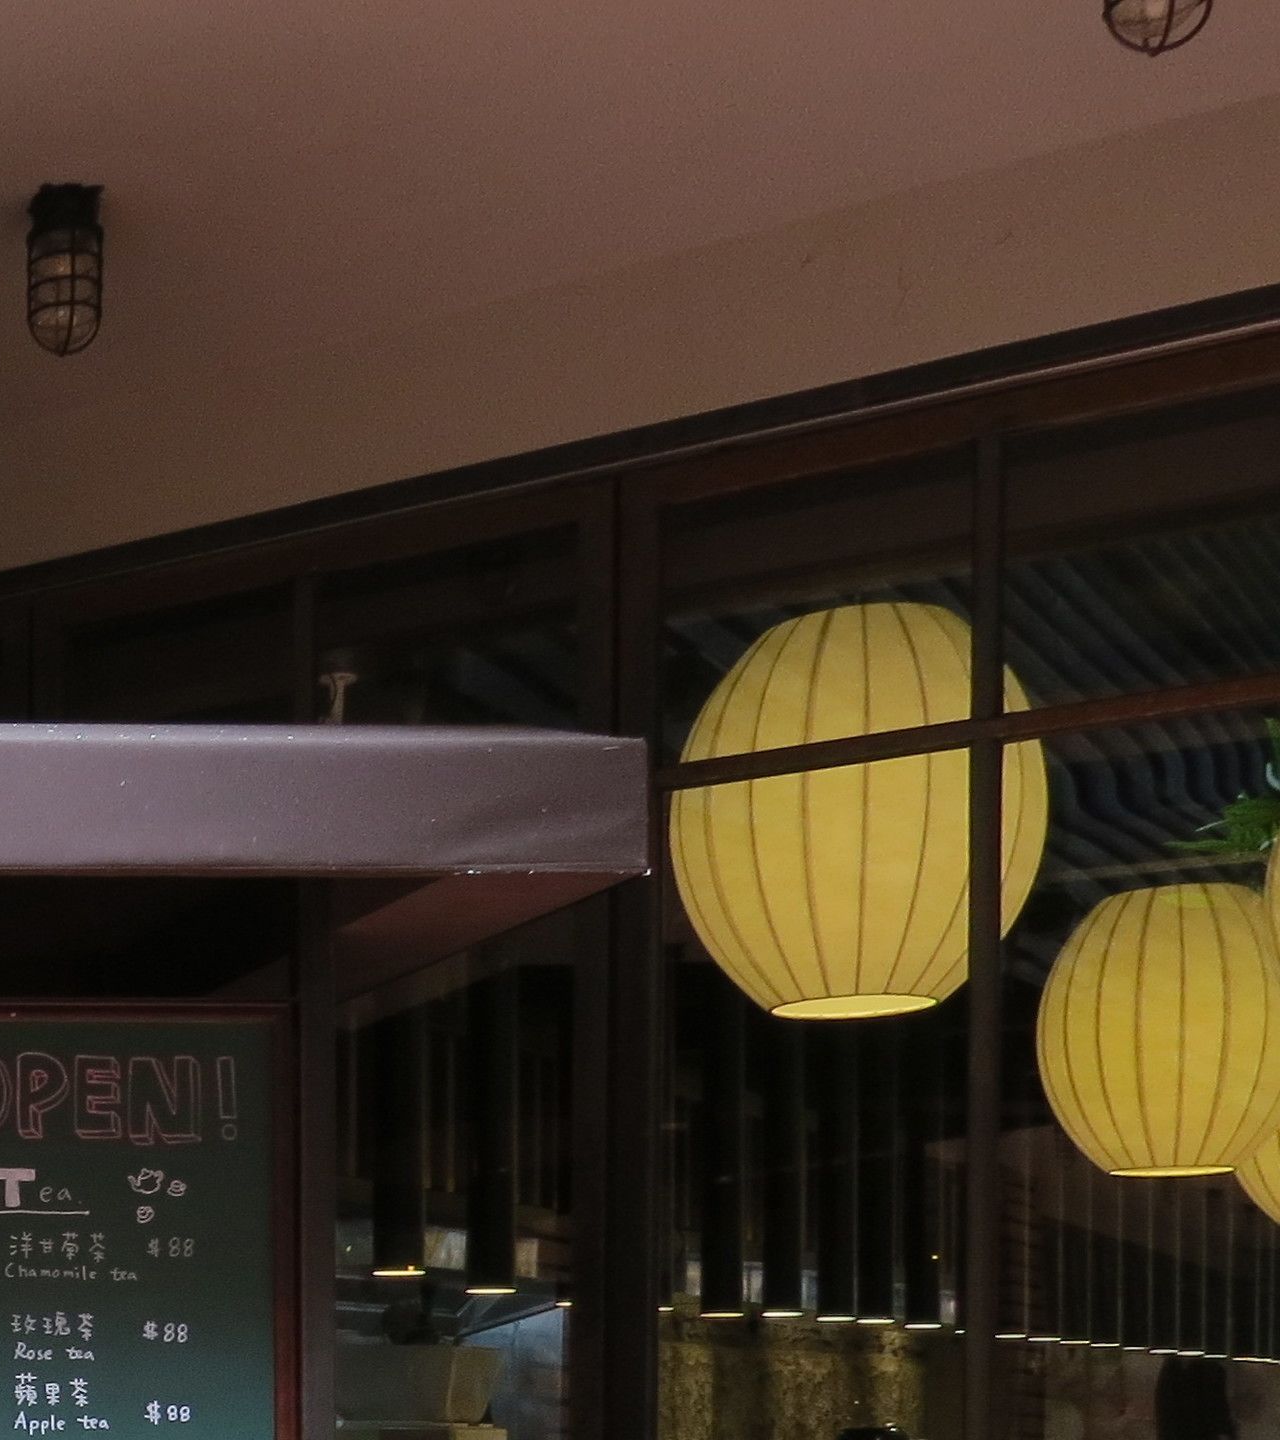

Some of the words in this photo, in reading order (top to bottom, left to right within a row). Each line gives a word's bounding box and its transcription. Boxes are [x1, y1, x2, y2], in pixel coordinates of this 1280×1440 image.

[9, 1232, 105, 1262] 洋甘菊茶
[147, 1237, 194, 1257] $88
[5, 1263, 96, 1280] Chamomile
[111, 1268, 137, 1281] tea
[11, 1311, 93, 1341] 玫瑰茶
[143, 1321, 188, 1343] $88
[14, 1342, 52, 1360] Rose
[65, 1346, 95, 1361] tea
[14, 1373, 88, 1407] 蘋果茶
[144, 1401, 191, 1425] $88
[14, 1411, 65, 1435] Apple
[77, 1415, 110, 1430] tea
